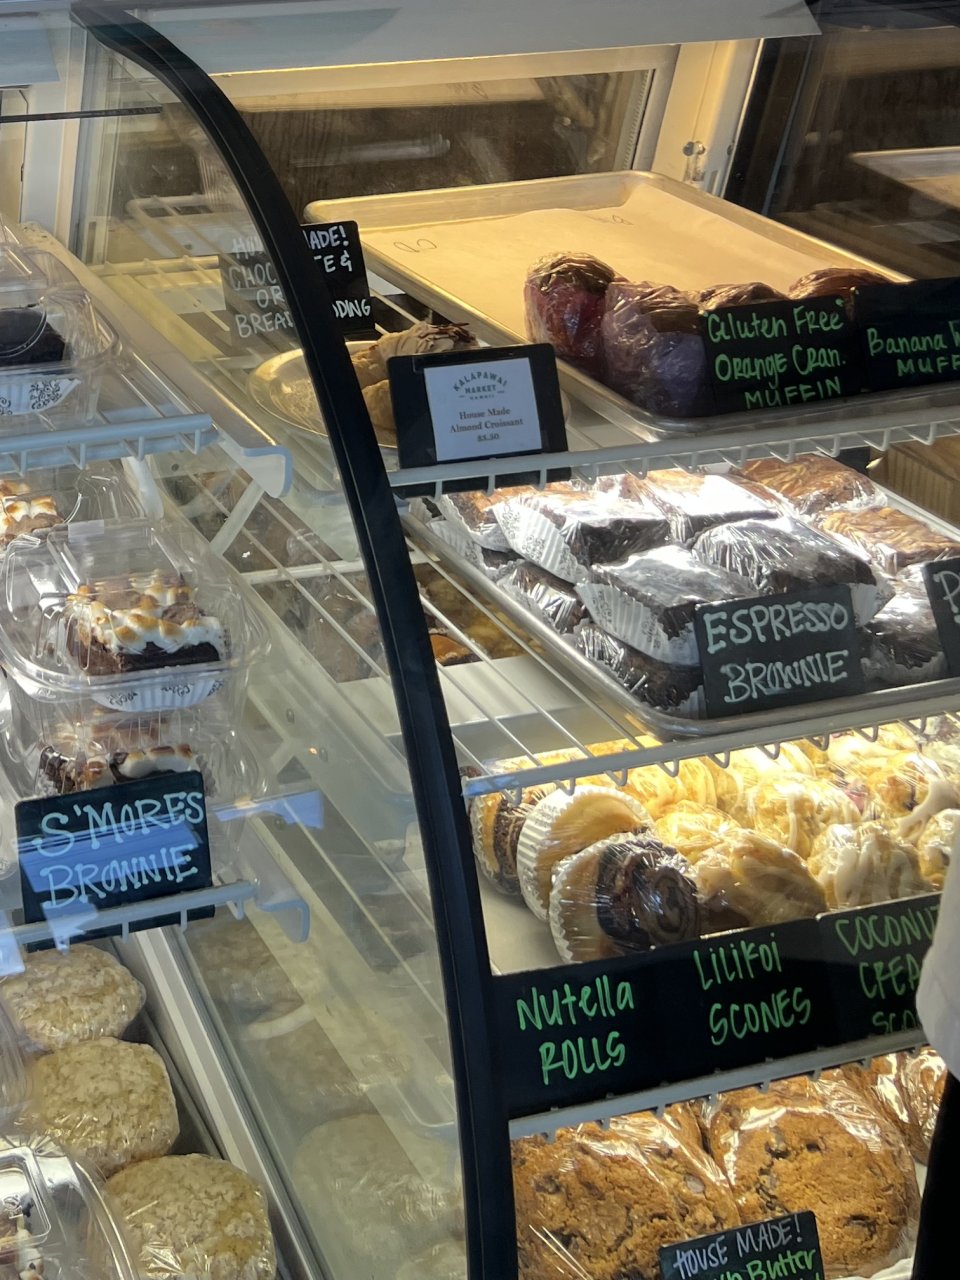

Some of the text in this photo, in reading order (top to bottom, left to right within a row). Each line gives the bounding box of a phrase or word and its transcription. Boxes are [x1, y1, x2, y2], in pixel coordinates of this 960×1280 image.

[302, 225, 350, 250] ADE!
[340, 250, 353, 272] &
[256, 285, 286, 309] OR
[866, 327, 948, 357] Banana
[792, 344, 846, 375] Cran.
[453, 371, 508, 392] KALAPAWAI
[465, 384, 497, 394] MARKET
[744, 376, 841, 410] MUFFIN
[450, 418, 524, 433] Almond Croissant
[459, 406, 511, 420] House Made
[703, 600, 849, 654] ESPRESSO
[720, 649, 849, 704] BROWNIE
[32, 791, 205, 857] S'MORES
[40, 843, 198, 909] BROWNIE
[515, 974, 635, 1032] Nutella
[709, 986, 811, 1046] SCONES
[538, 1030, 626, 1086] ROLLS
[673, 1213, 803, 1280] HOUSE MADE!
